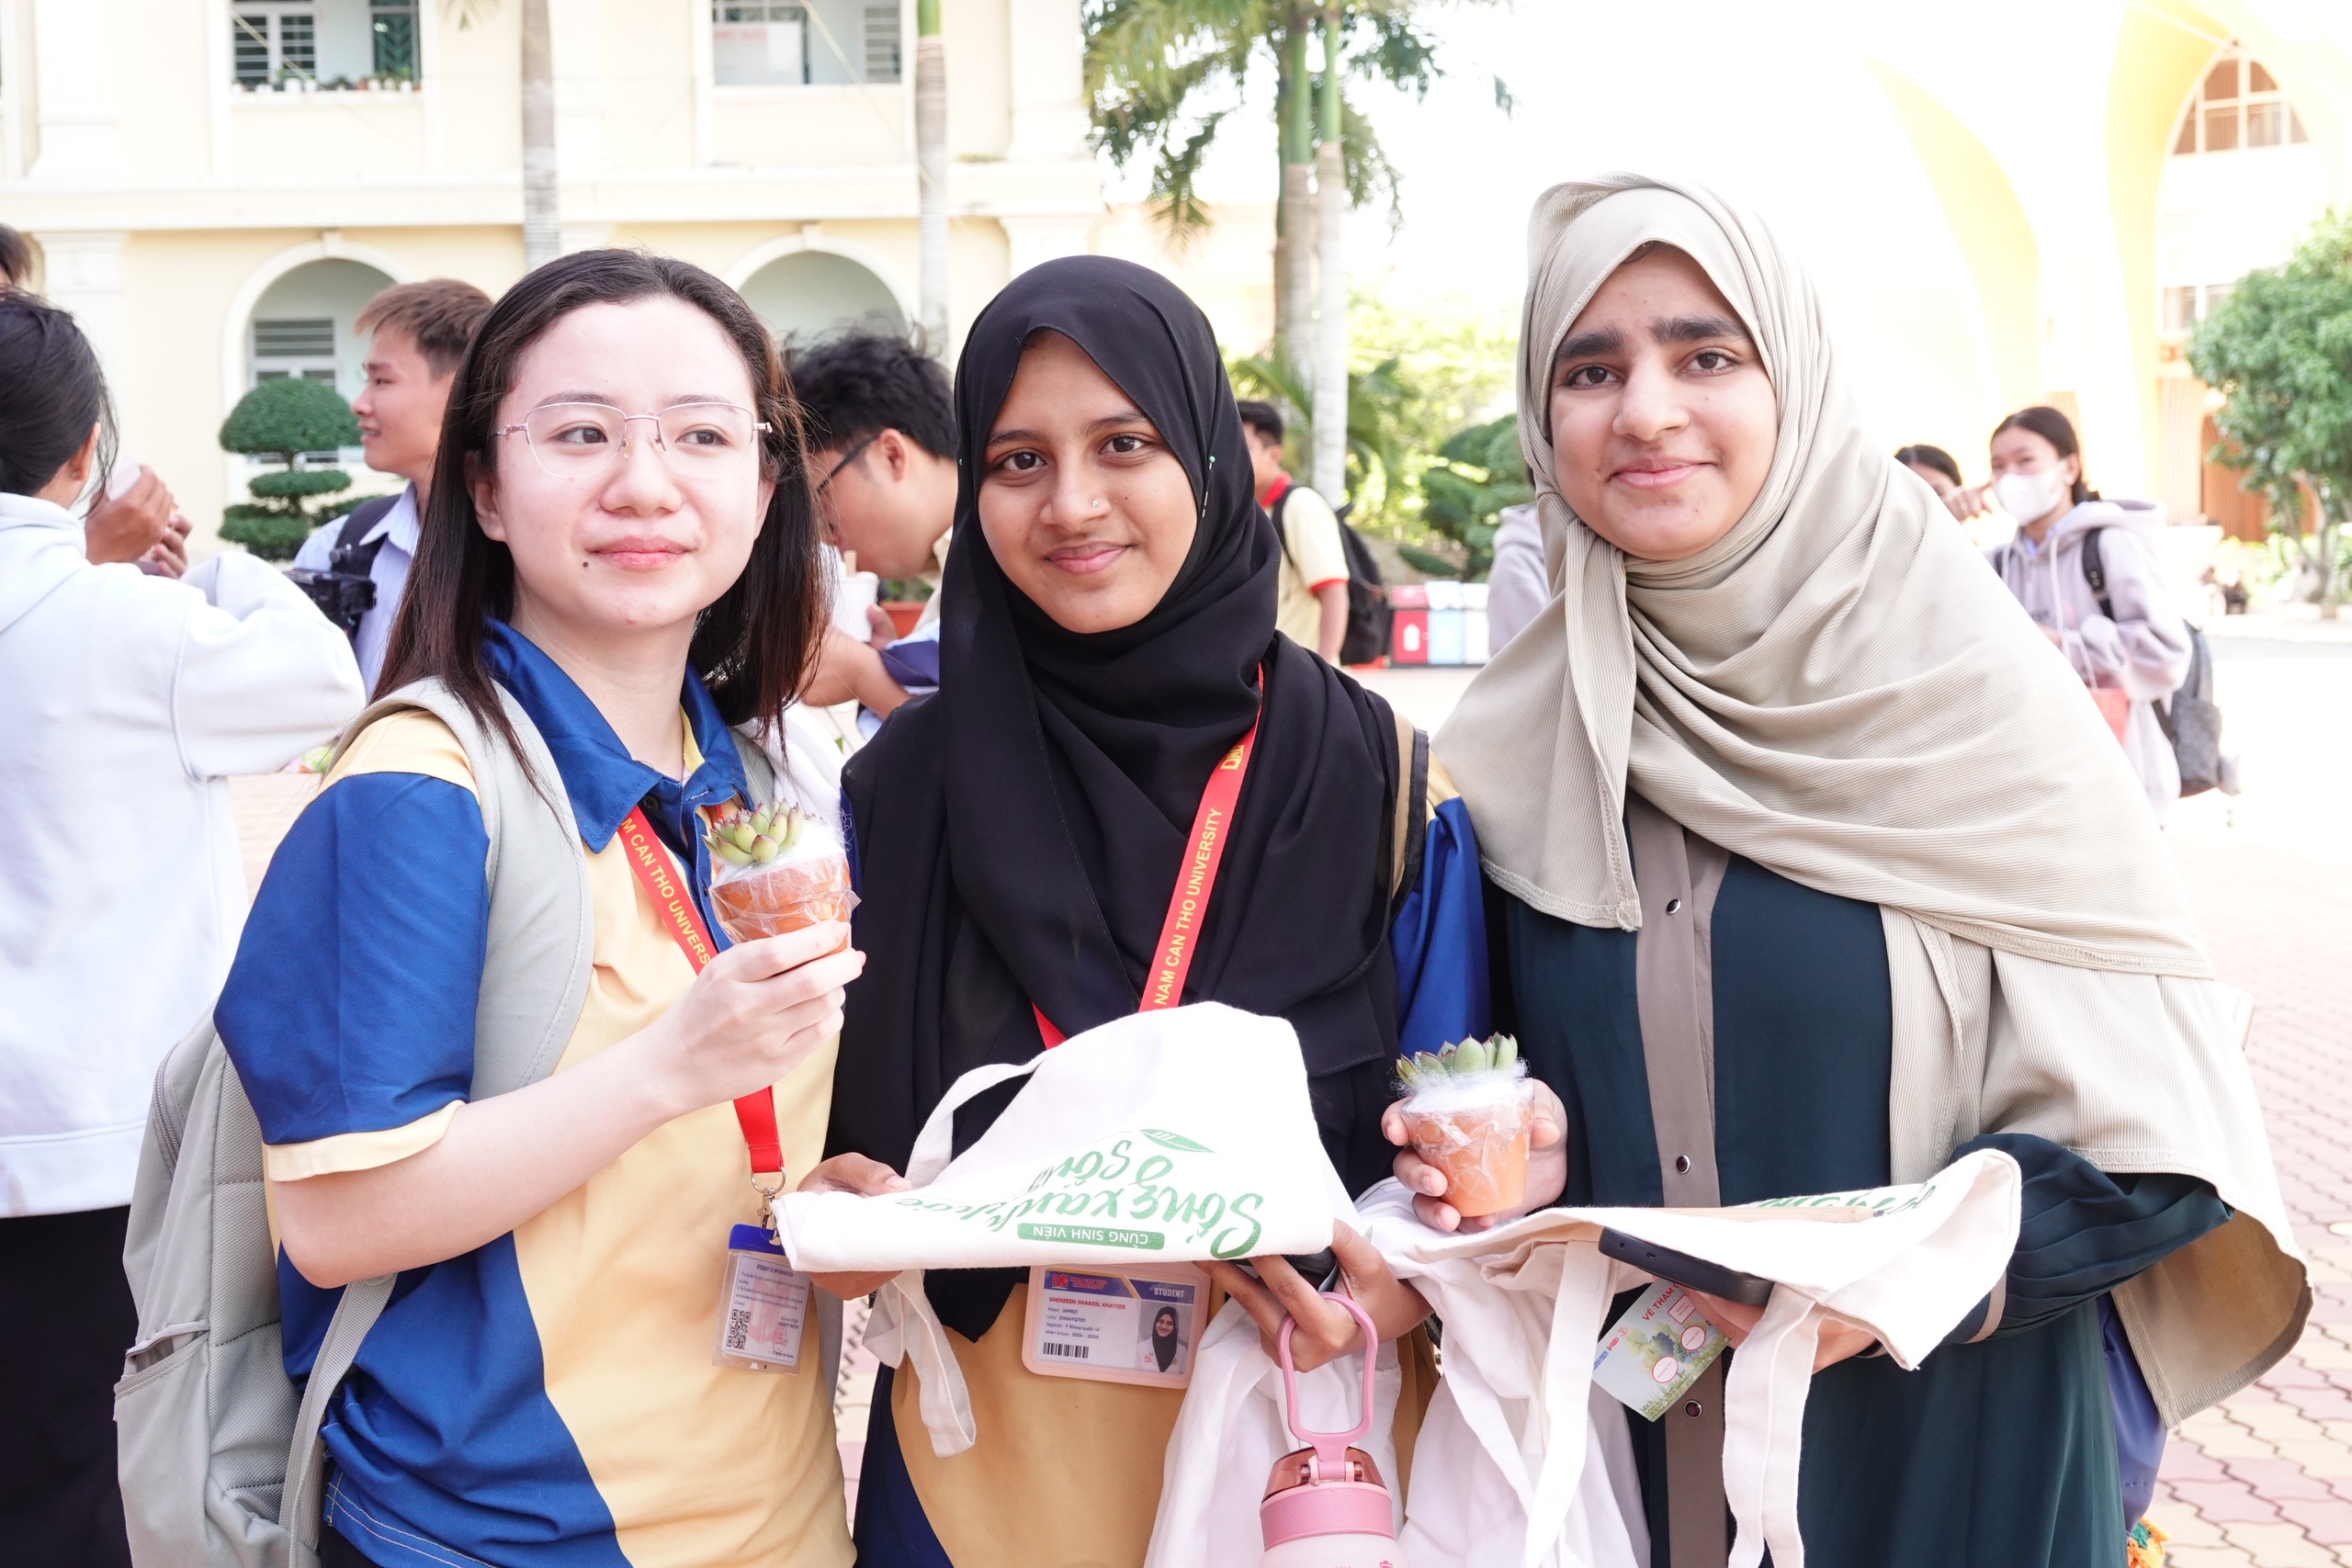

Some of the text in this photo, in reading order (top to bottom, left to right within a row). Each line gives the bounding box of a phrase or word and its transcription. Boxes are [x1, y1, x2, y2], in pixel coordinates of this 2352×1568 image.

[630, 833, 710, 964] CAN THO UNIVERS
[1154, 807, 1222, 1006] NAM CAN THO UNIVERSITY
[1033, 1225, 1149, 1249] CÙNG SINH VIÊN
[1128, 1156, 1263, 1260] Sống
[1153, 1287, 1185, 1298] STUDENT
[1653, 1287, 1675, 1310] THAM
